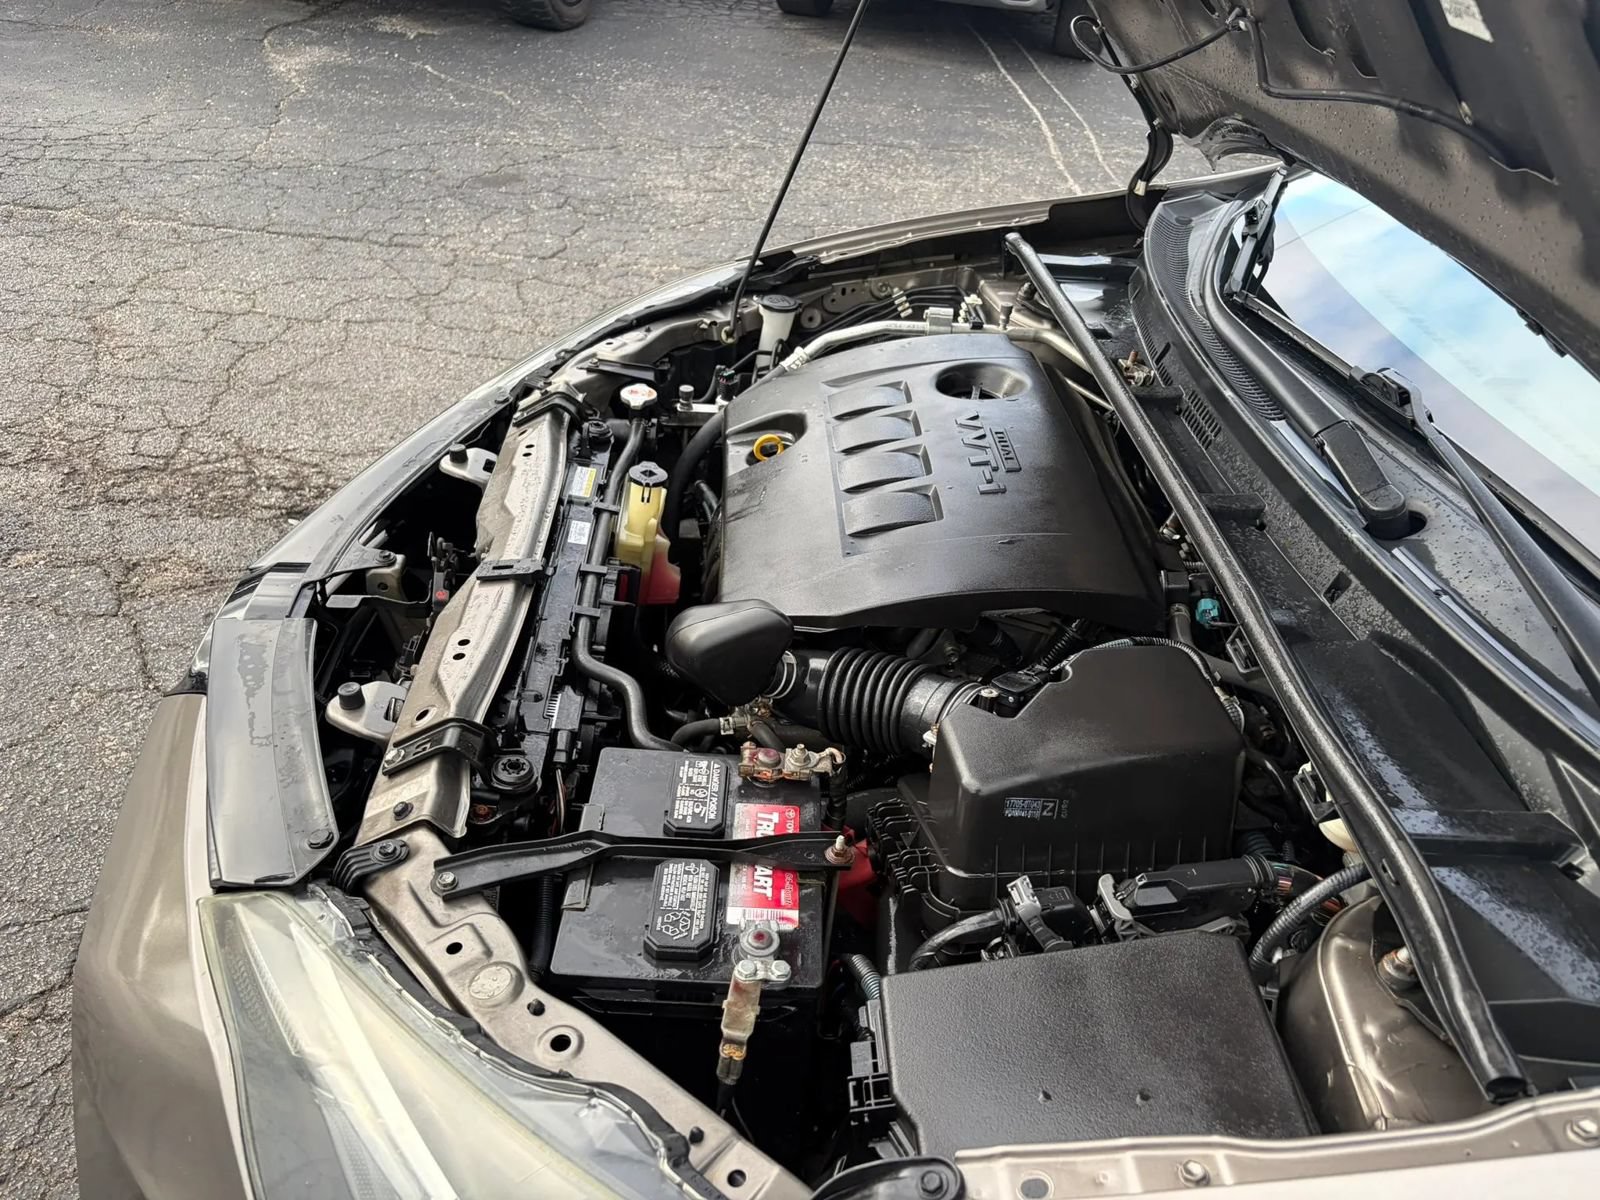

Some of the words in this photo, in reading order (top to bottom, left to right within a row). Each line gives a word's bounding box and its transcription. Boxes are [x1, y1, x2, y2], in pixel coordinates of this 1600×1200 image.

[954, 411, 1007, 495] VVT-i
[994, 431, 1015, 466] DUAL
[711, 769, 721, 792] DANGER
[708, 797, 718, 820] POISON
[786, 819, 795, 834] TOY
